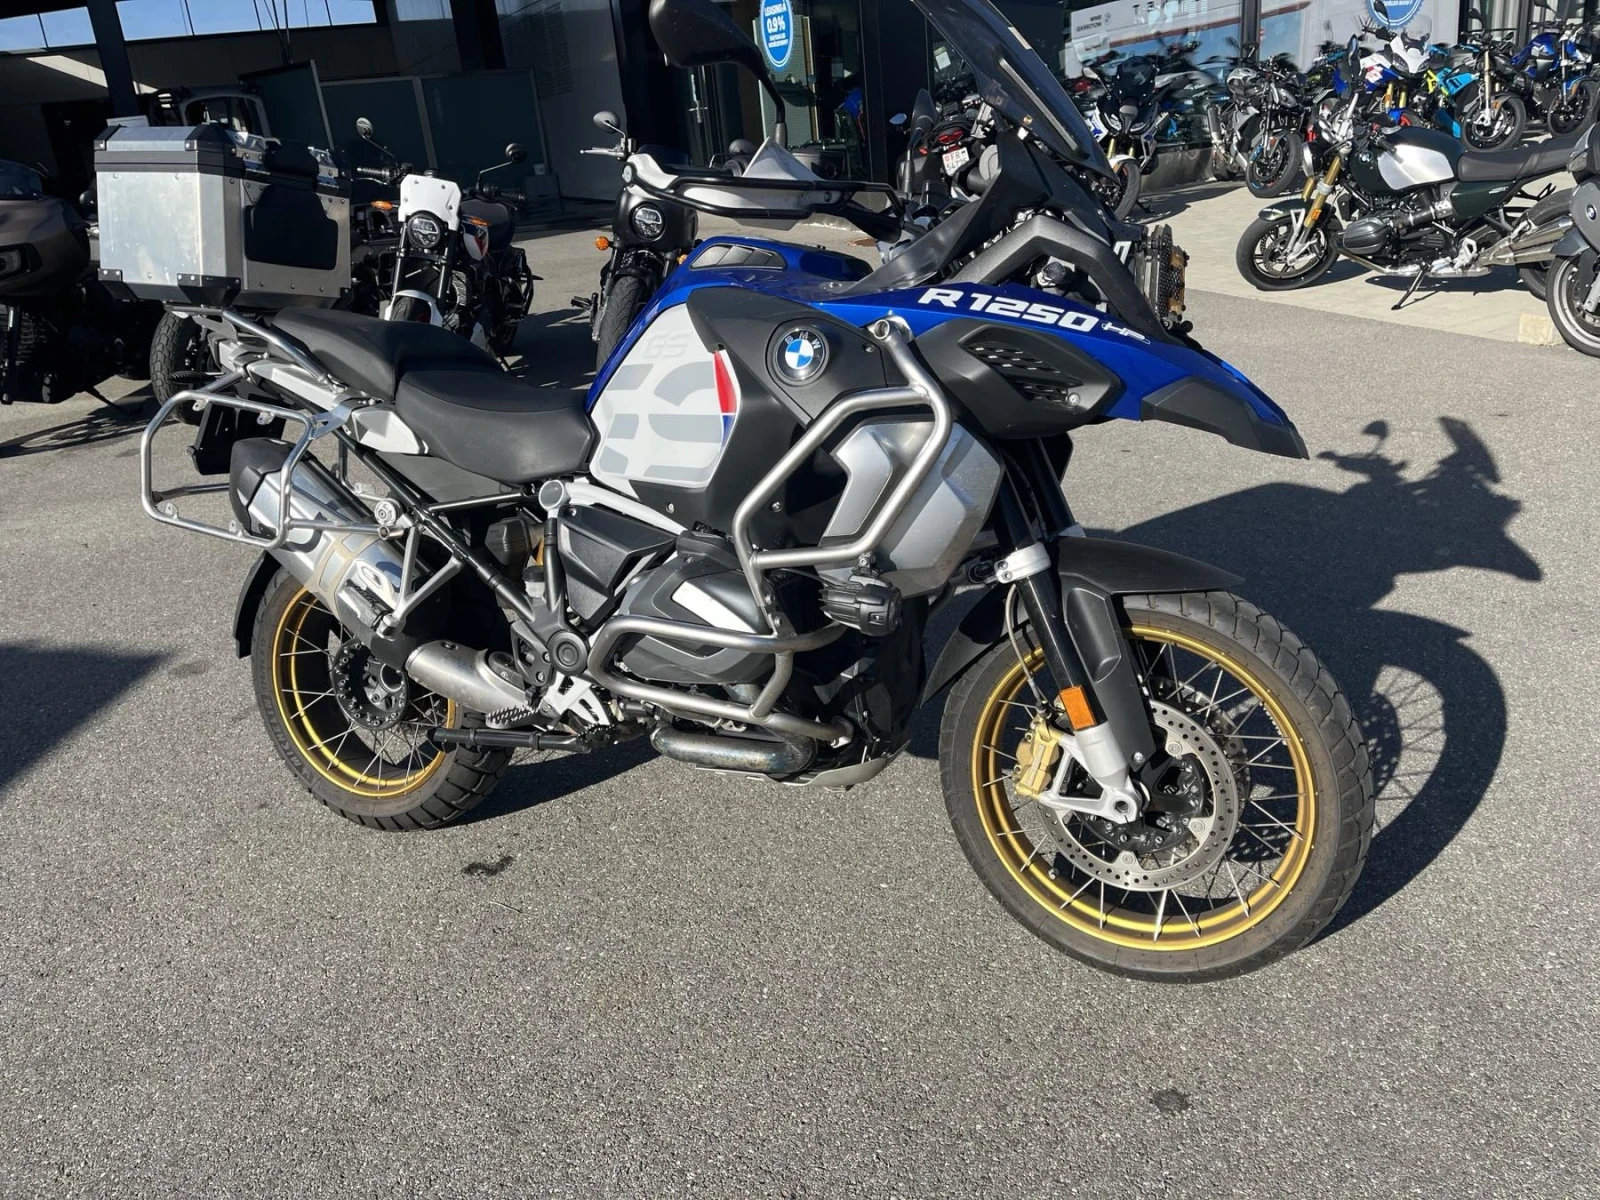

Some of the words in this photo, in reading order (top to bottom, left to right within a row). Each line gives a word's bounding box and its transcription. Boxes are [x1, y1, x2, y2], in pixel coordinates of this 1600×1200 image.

[917, 287, 961, 309] R
[969, 292, 1100, 333] 1250
[1102, 321, 1150, 345] HP
[784, 330, 822, 351] BMW
